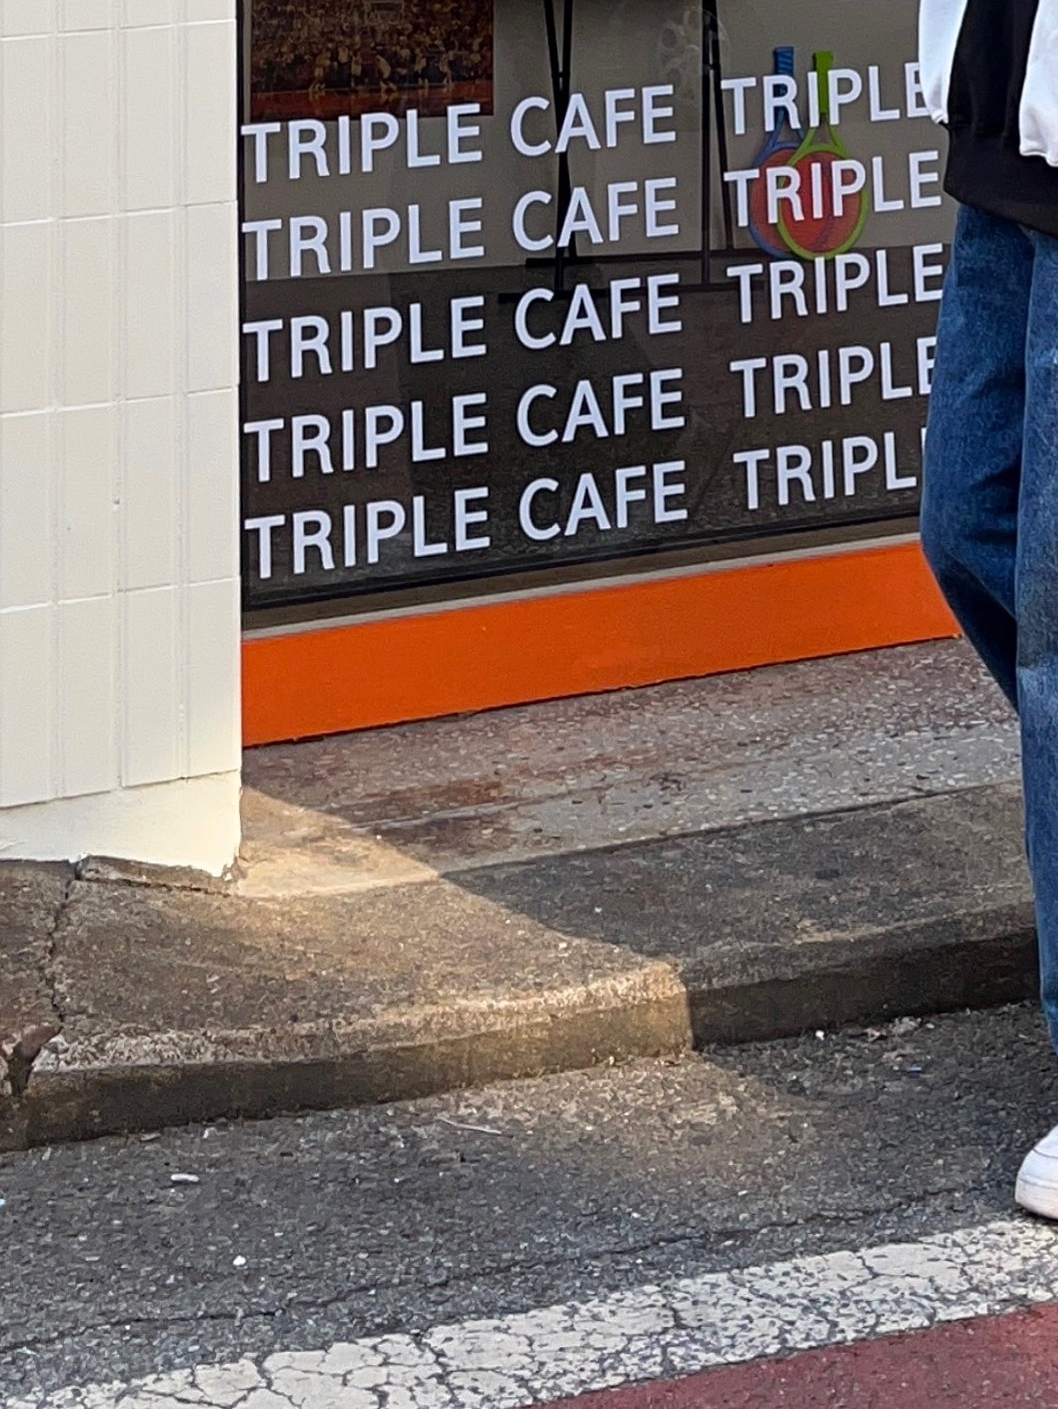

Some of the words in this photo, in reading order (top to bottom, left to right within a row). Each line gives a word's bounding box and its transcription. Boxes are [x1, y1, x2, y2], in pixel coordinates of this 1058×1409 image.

[241, 104, 482, 182] TRIPLE
[511, 85, 675, 155] CAFE
[721, 62, 931, 134] TRIPLE
[242, 198, 484, 280] TRIPLE
[514, 178, 678, 250] CAFE
[724, 151, 941, 226] TRIPLE
[243, 296, 485, 381] TRIPLE
[516, 274, 681, 348] CAFE
[727, 243, 943, 322] TRIPLE
[244, 394, 487, 481] TRIPLE
[518, 369, 684, 445] CAFE
[245, 487, 489, 578] TRIPLE
[520, 461, 687, 539] CAFE
[734, 432, 926, 509] TRIPL
